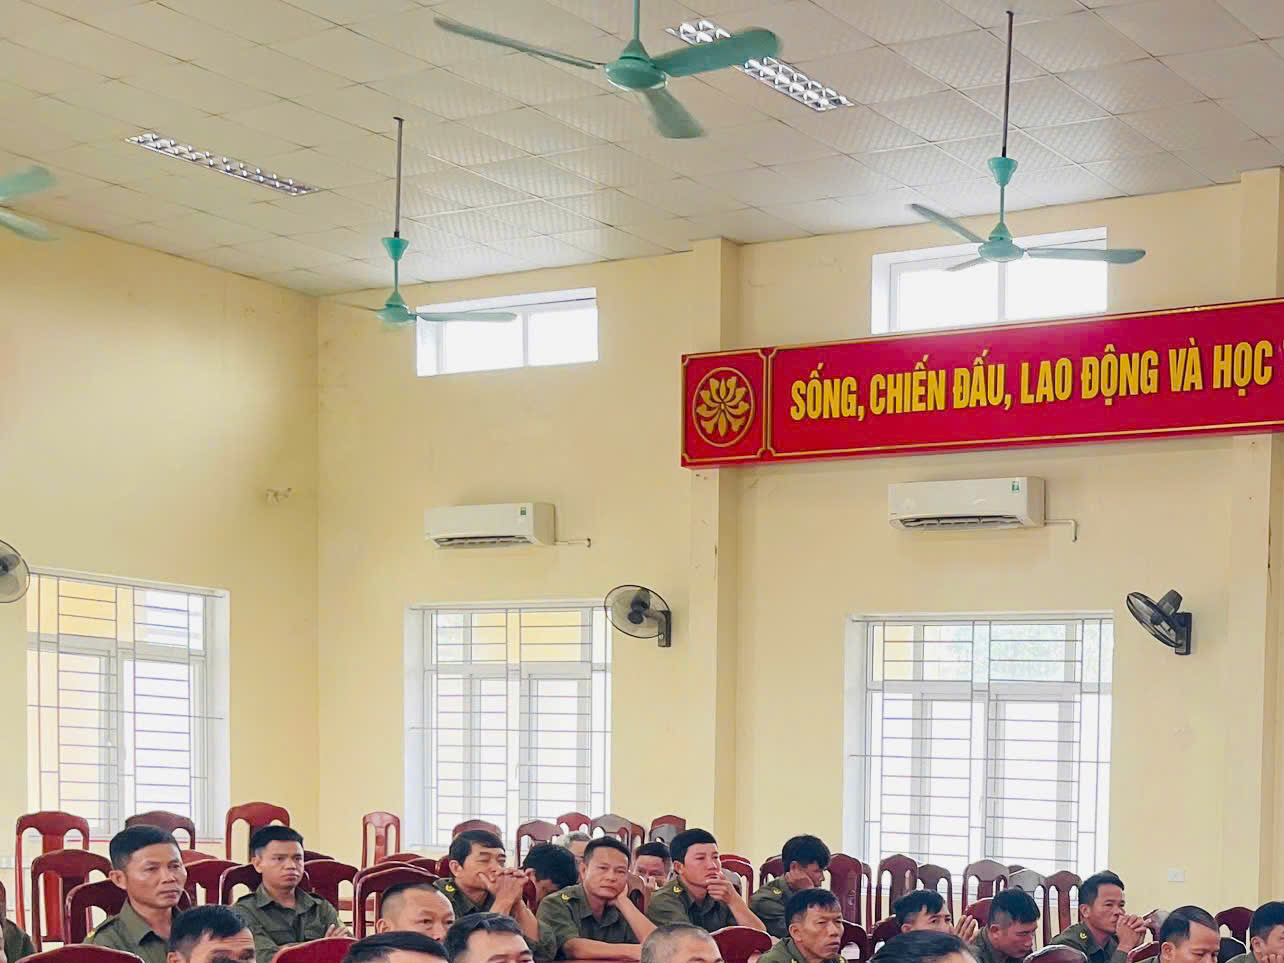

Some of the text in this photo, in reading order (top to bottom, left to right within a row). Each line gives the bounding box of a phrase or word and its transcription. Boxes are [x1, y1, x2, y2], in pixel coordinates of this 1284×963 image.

[790, 362, 865, 422] SỐNG,
[870, 354, 946, 415] CHIẾN
[952, 349, 1012, 410] ĐẤU,
[1020, 357, 1073, 404] LAO
[1081, 343, 1159, 406] ĐỘNG
[1168, 337, 1203, 392] VÀ
[1212, 338, 1273, 397] HỌC
